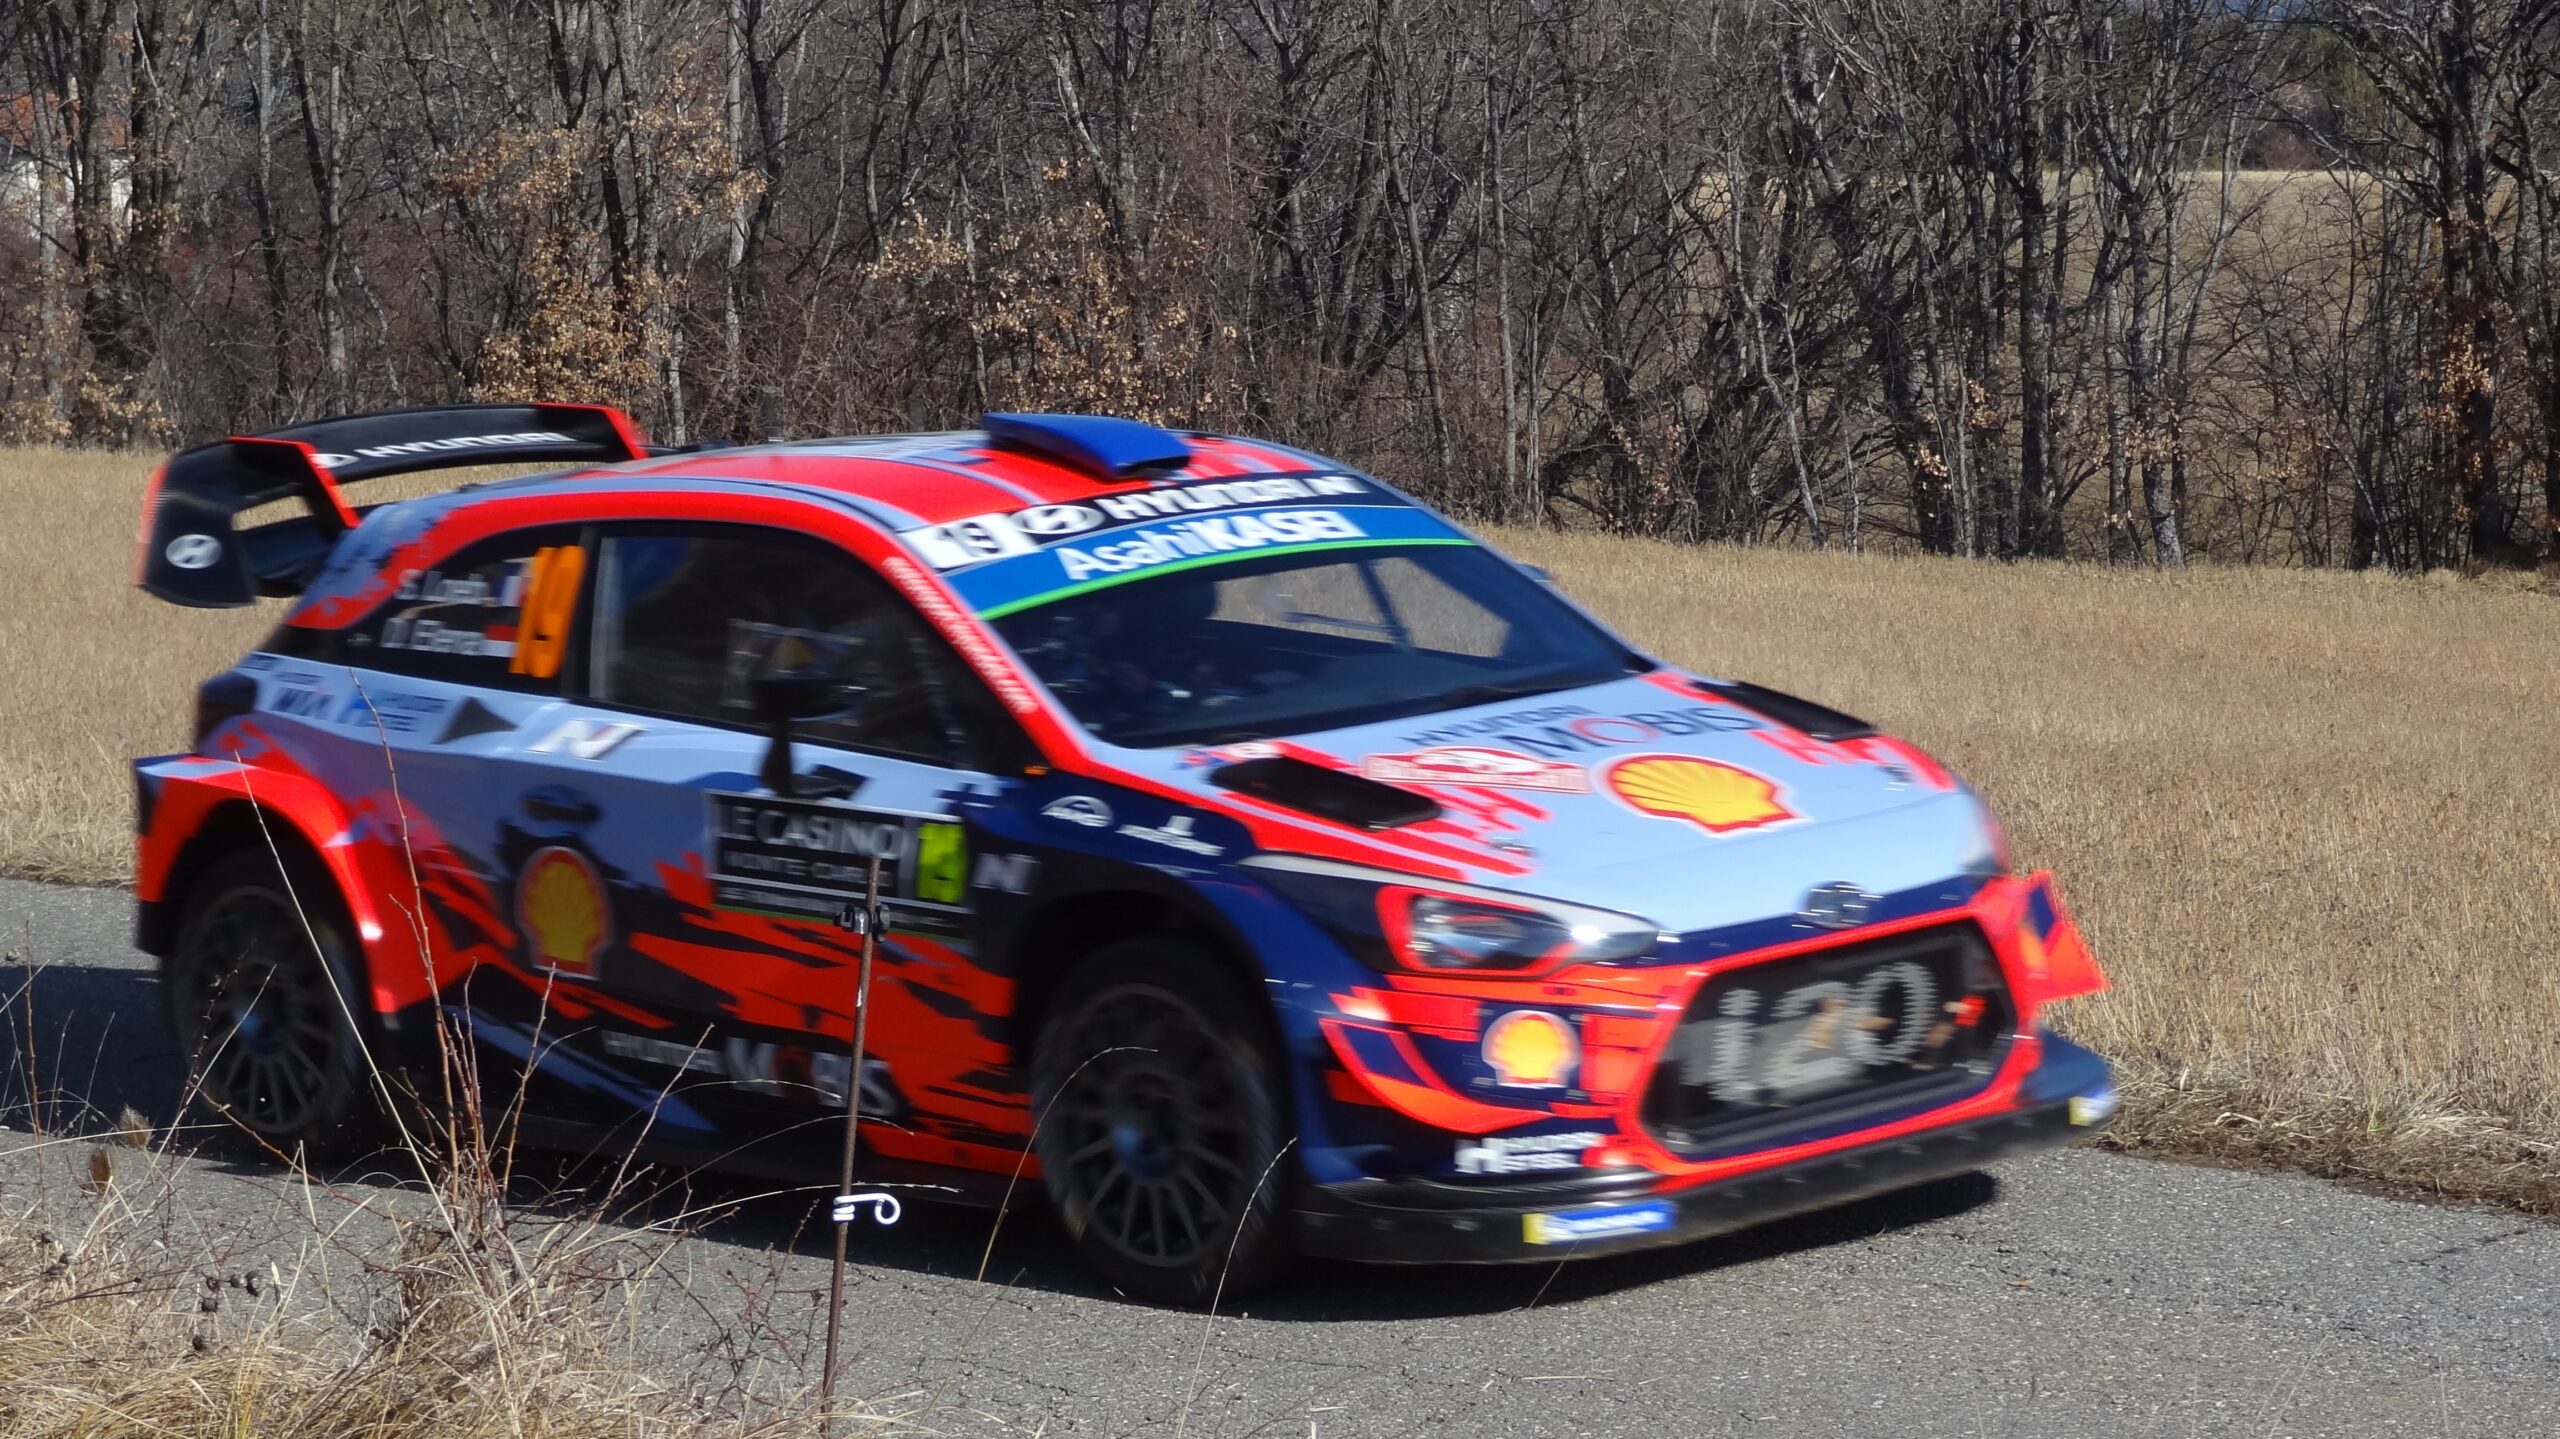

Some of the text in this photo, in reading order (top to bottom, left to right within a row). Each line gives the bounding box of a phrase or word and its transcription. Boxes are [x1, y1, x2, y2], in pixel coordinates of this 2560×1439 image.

[354, 431, 578, 458] HYUNDAI
[1094, 480, 1312, 520] HYUNDAI
[1054, 511, 1370, 580] AsahiKASEI
[1497, 706, 1764, 758] MOBIS
[755, 809, 905, 861] CASINO
[1704, 961, 1938, 1105] i20
